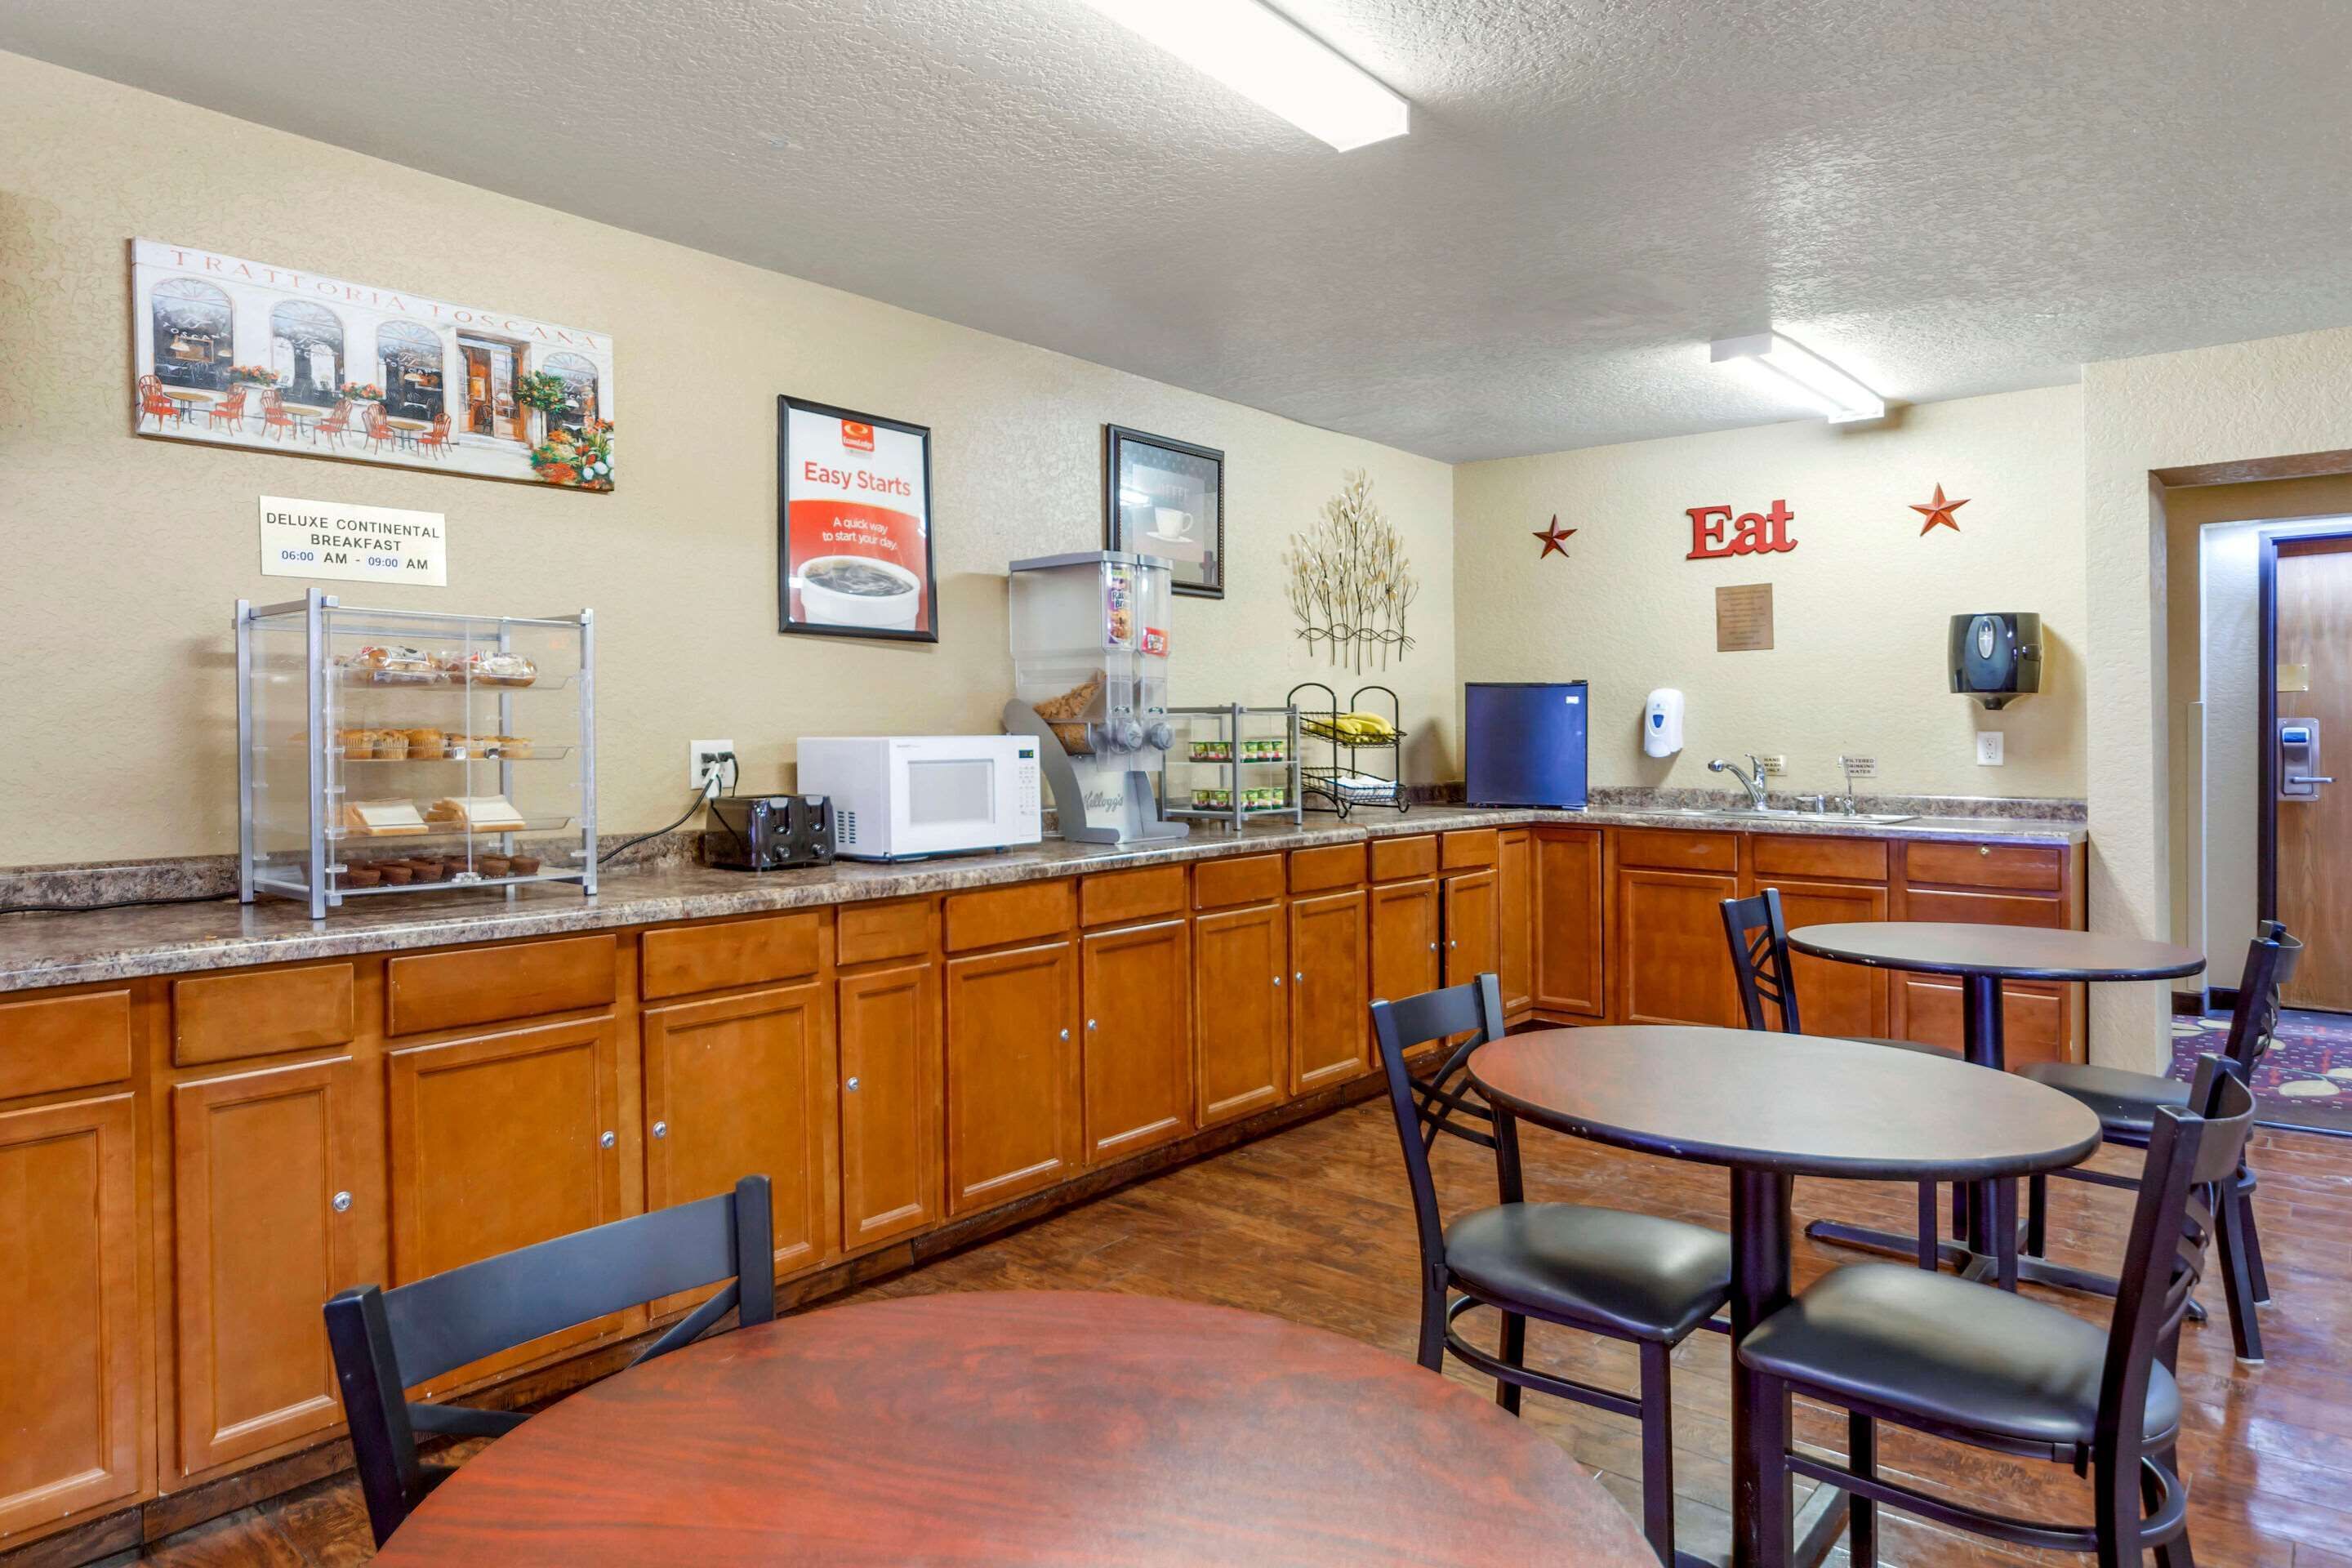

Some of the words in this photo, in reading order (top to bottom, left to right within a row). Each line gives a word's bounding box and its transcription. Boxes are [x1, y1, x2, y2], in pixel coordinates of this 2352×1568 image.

[170, 249, 406, 311] TRATTORIA
[427, 304, 598, 350] TOSCANA
[804, 461, 852, 490] Easy
[857, 470, 911, 497] Starts
[266, 512, 329, 529] DELUXE
[336, 519, 440, 539] CONTINENTAL
[833, 516, 842, 528] A
[843, 518, 868, 530] quick
[869, 522, 889, 535] way
[1686, 499, 1798, 561] Eat
[310, 533, 402, 551] BREAKFAST
[822, 531, 834, 542] to
[835, 531, 858, 542] start
[858, 534, 879, 545] your
[880, 537, 898, 550] day.
[281, 550, 314, 561] 06:00
[323, 552, 347, 564] AM
[368, 556, 399, 568] 09:00
[406, 558, 429, 570] AM
